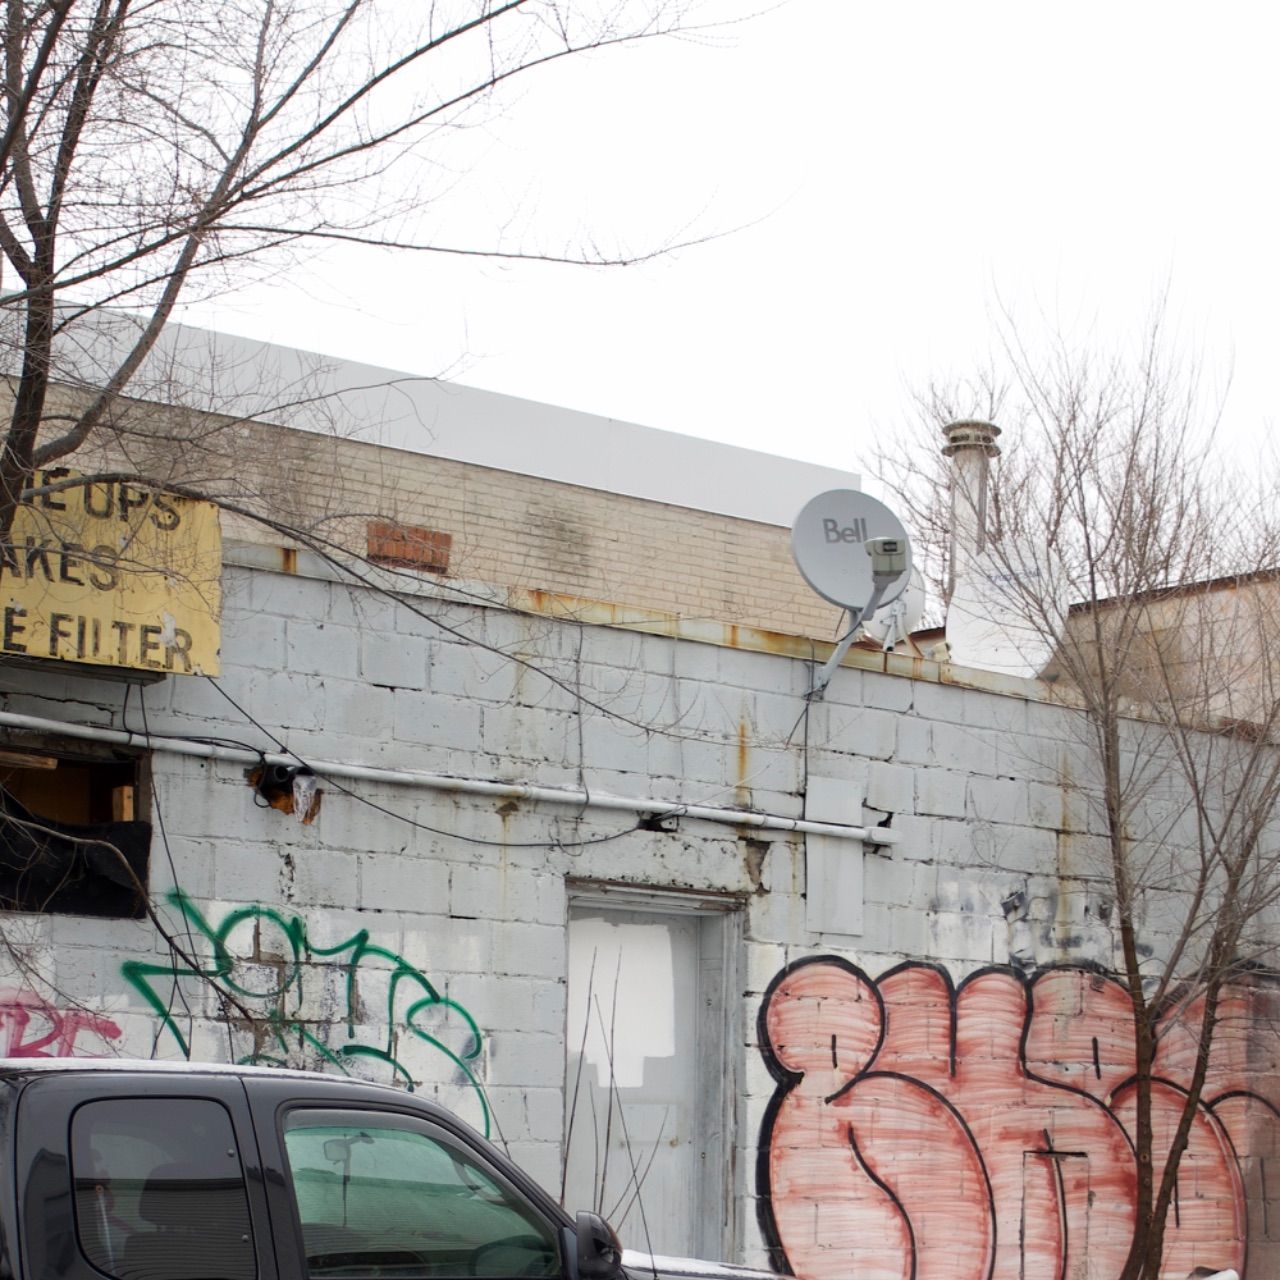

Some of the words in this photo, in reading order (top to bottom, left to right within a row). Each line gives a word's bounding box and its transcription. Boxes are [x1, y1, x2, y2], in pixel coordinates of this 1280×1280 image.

[83, 480, 181, 531] UPS
[822, 517, 868, 544] Bell
[49, 612, 193, 673] FILTER
